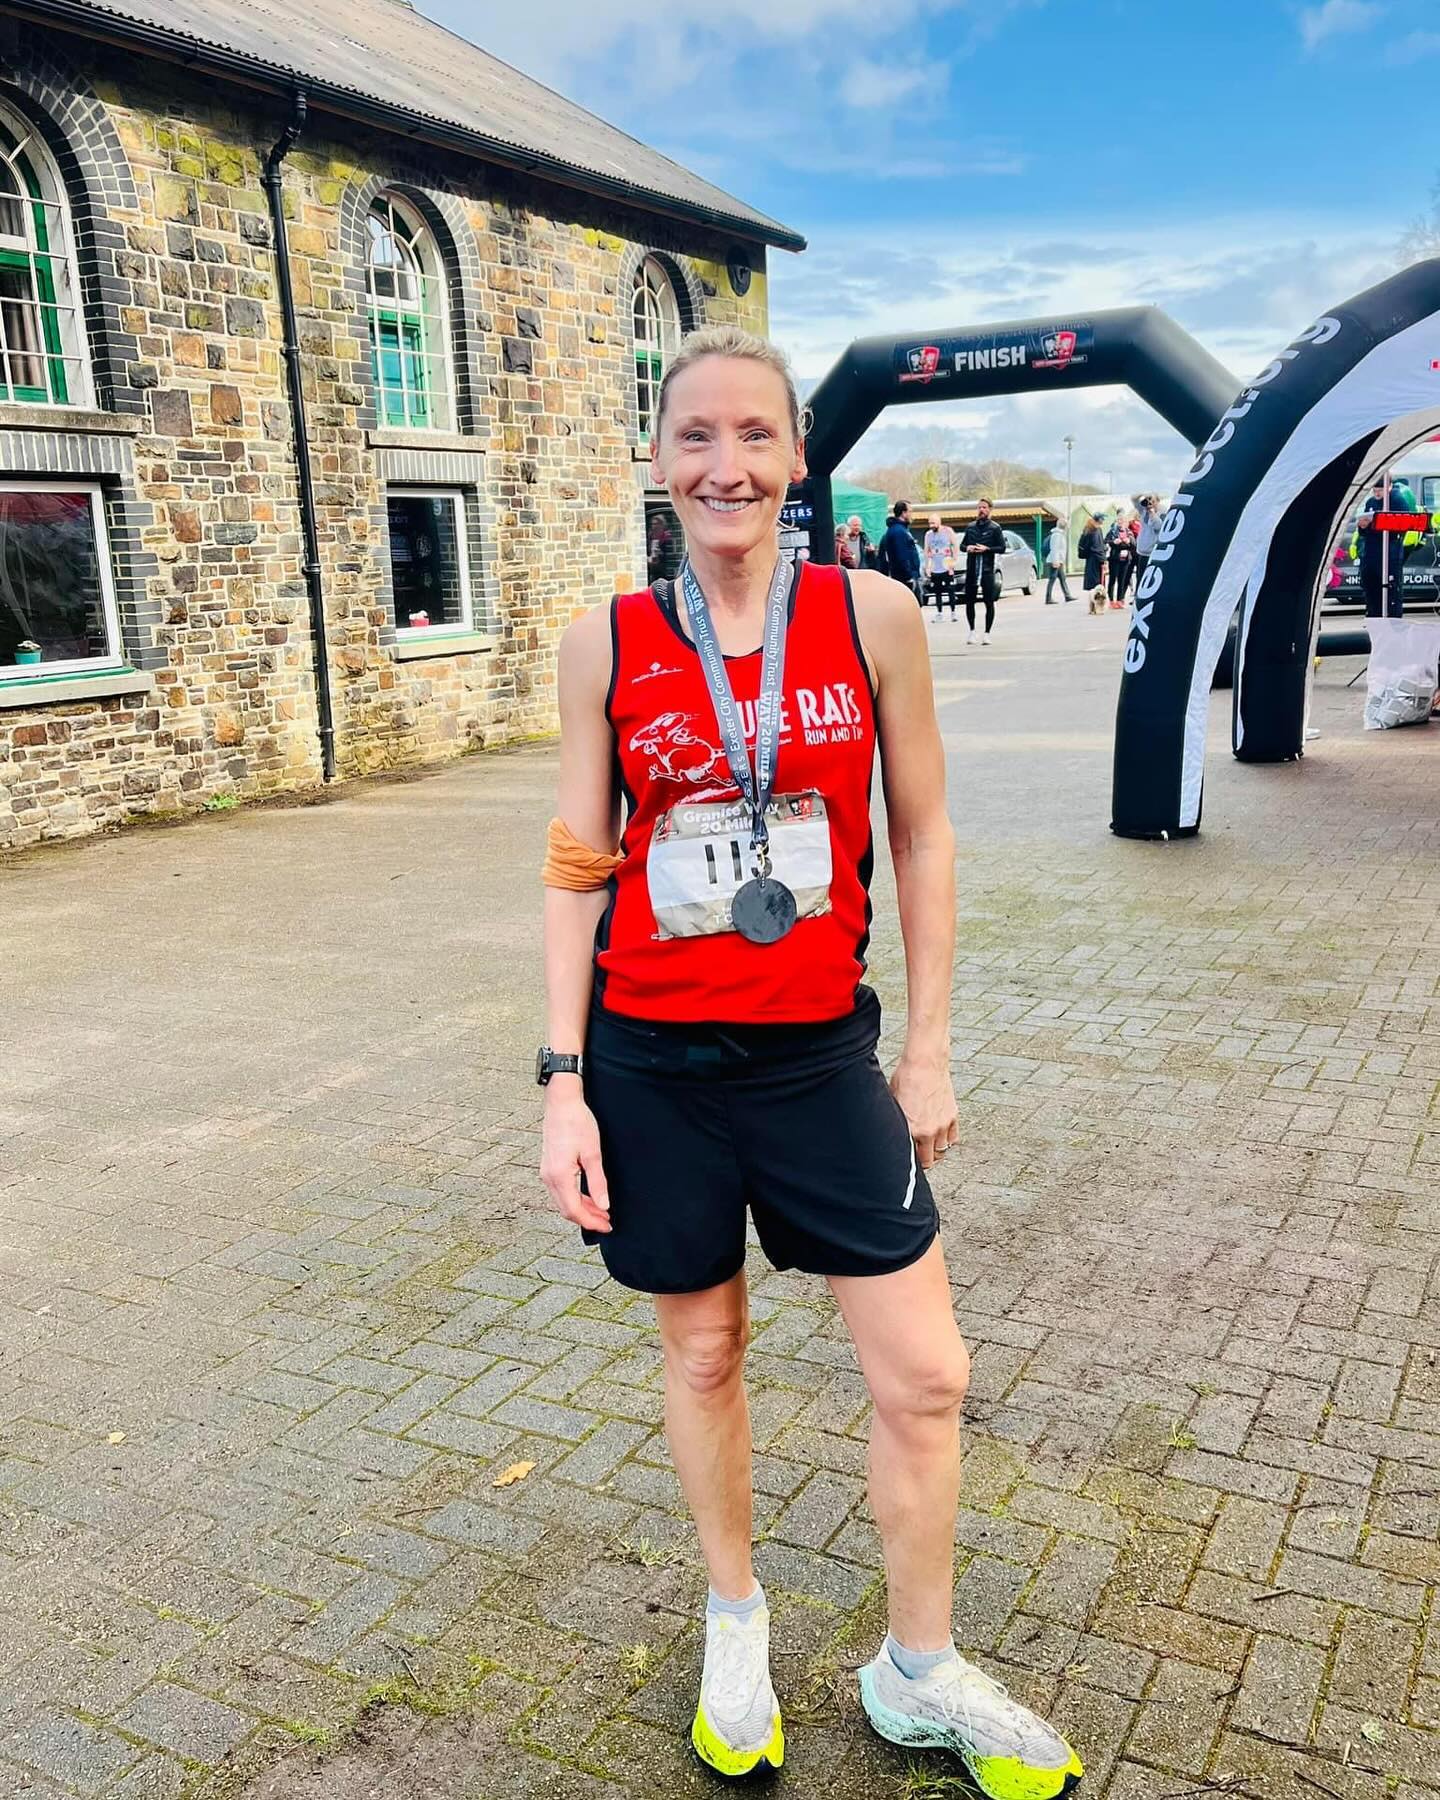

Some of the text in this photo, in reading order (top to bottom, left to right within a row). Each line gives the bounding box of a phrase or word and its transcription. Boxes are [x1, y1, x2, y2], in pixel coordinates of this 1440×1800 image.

[954, 345, 1026, 371] FINISH
[781, 507, 813, 519] ZERS
[772, 585, 786, 604] City
[695, 614, 709, 641] Trust
[767, 605, 783, 657] Community
[703, 640, 726, 696] Community
[767, 661, 778, 687] Trust
[719, 695, 732, 716] City
[725, 717, 741, 752] Exeter
[760, 690, 773, 791] WAY 20 MILER
[804, 729, 828, 746] RUN
[831, 727, 850, 743] AND
[683, 806, 741, 823] Granite
[701, 822, 721, 834] 20
